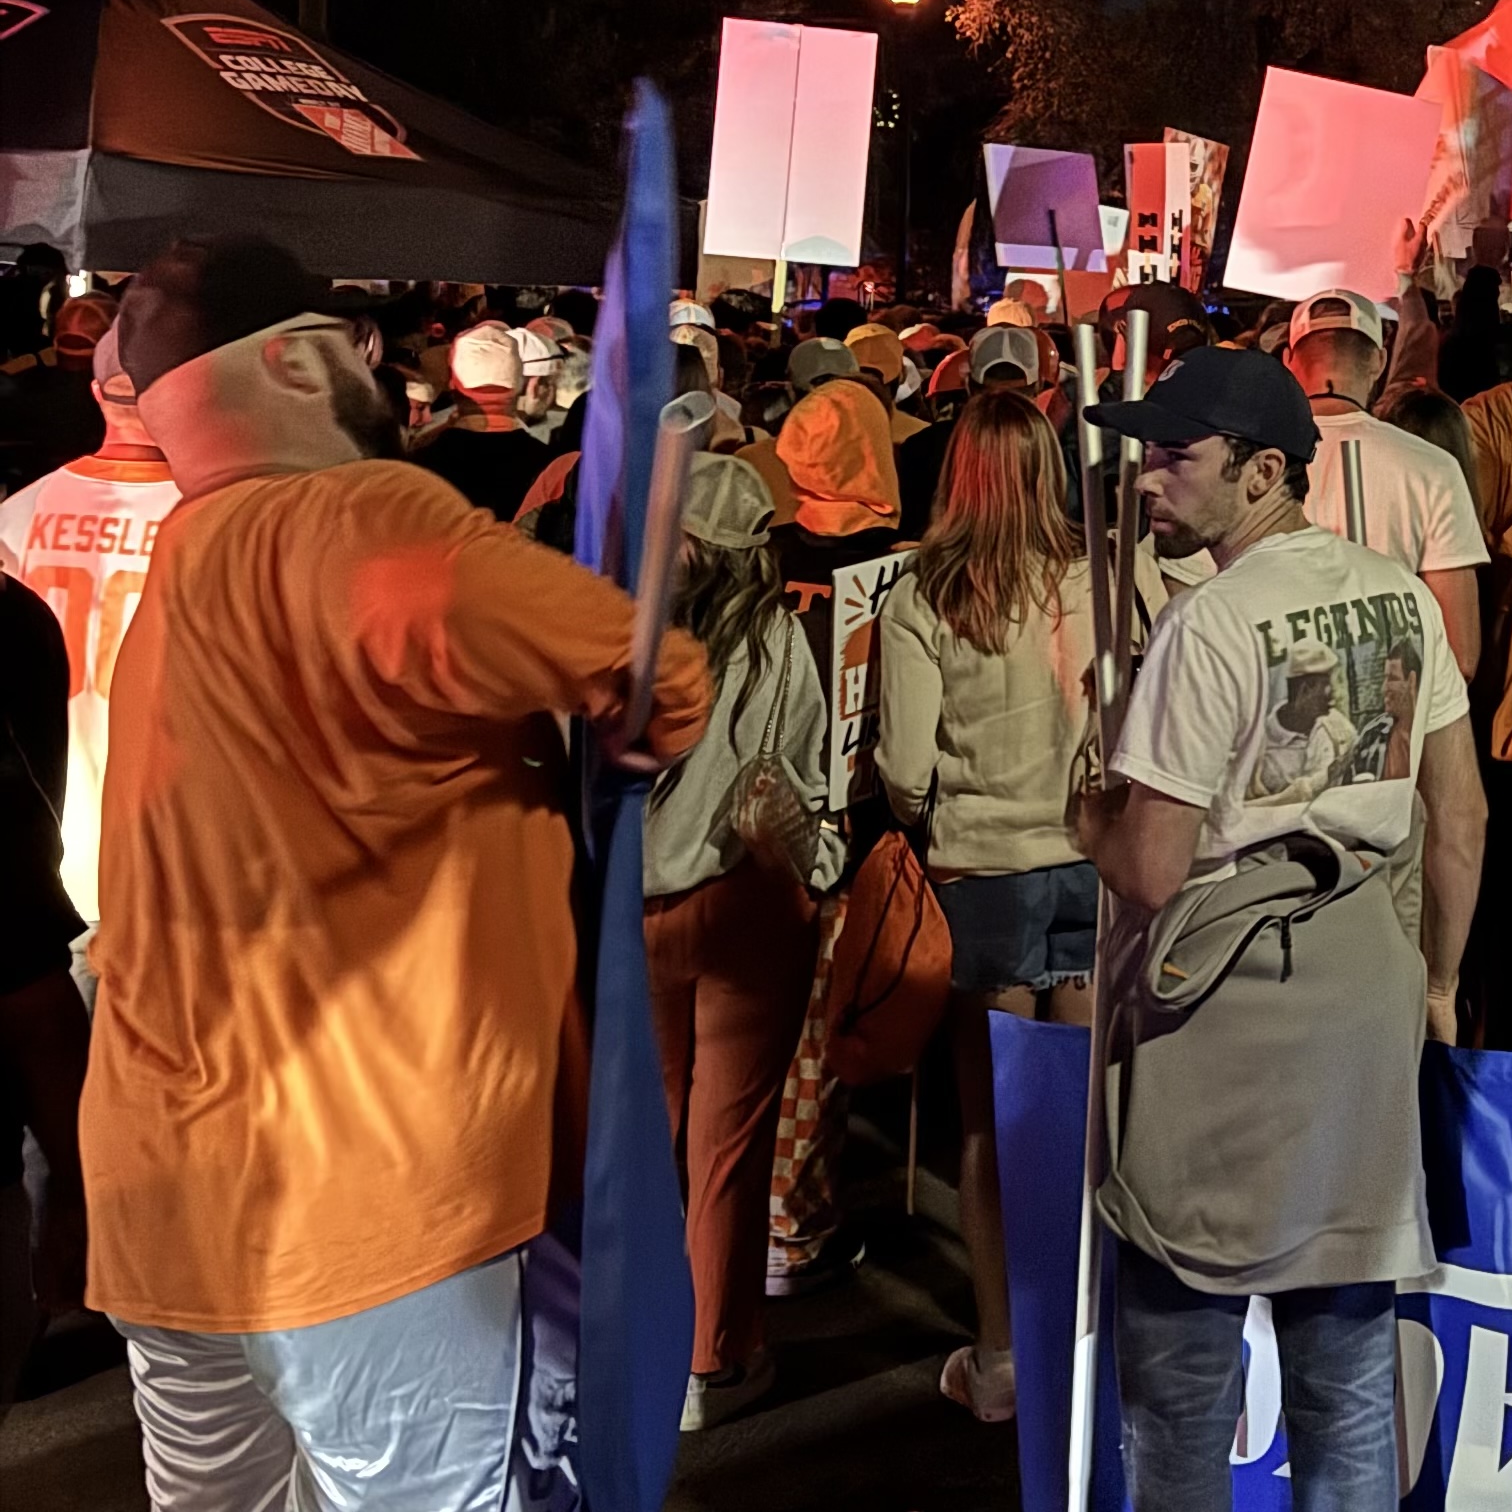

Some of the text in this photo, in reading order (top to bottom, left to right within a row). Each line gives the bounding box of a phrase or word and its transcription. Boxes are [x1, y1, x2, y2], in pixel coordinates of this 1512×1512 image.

[218, 53, 336, 82] COLLEGE
[219, 70, 370, 103] GAMEDAY
[1256, 592, 1423, 669] LEGENDS
